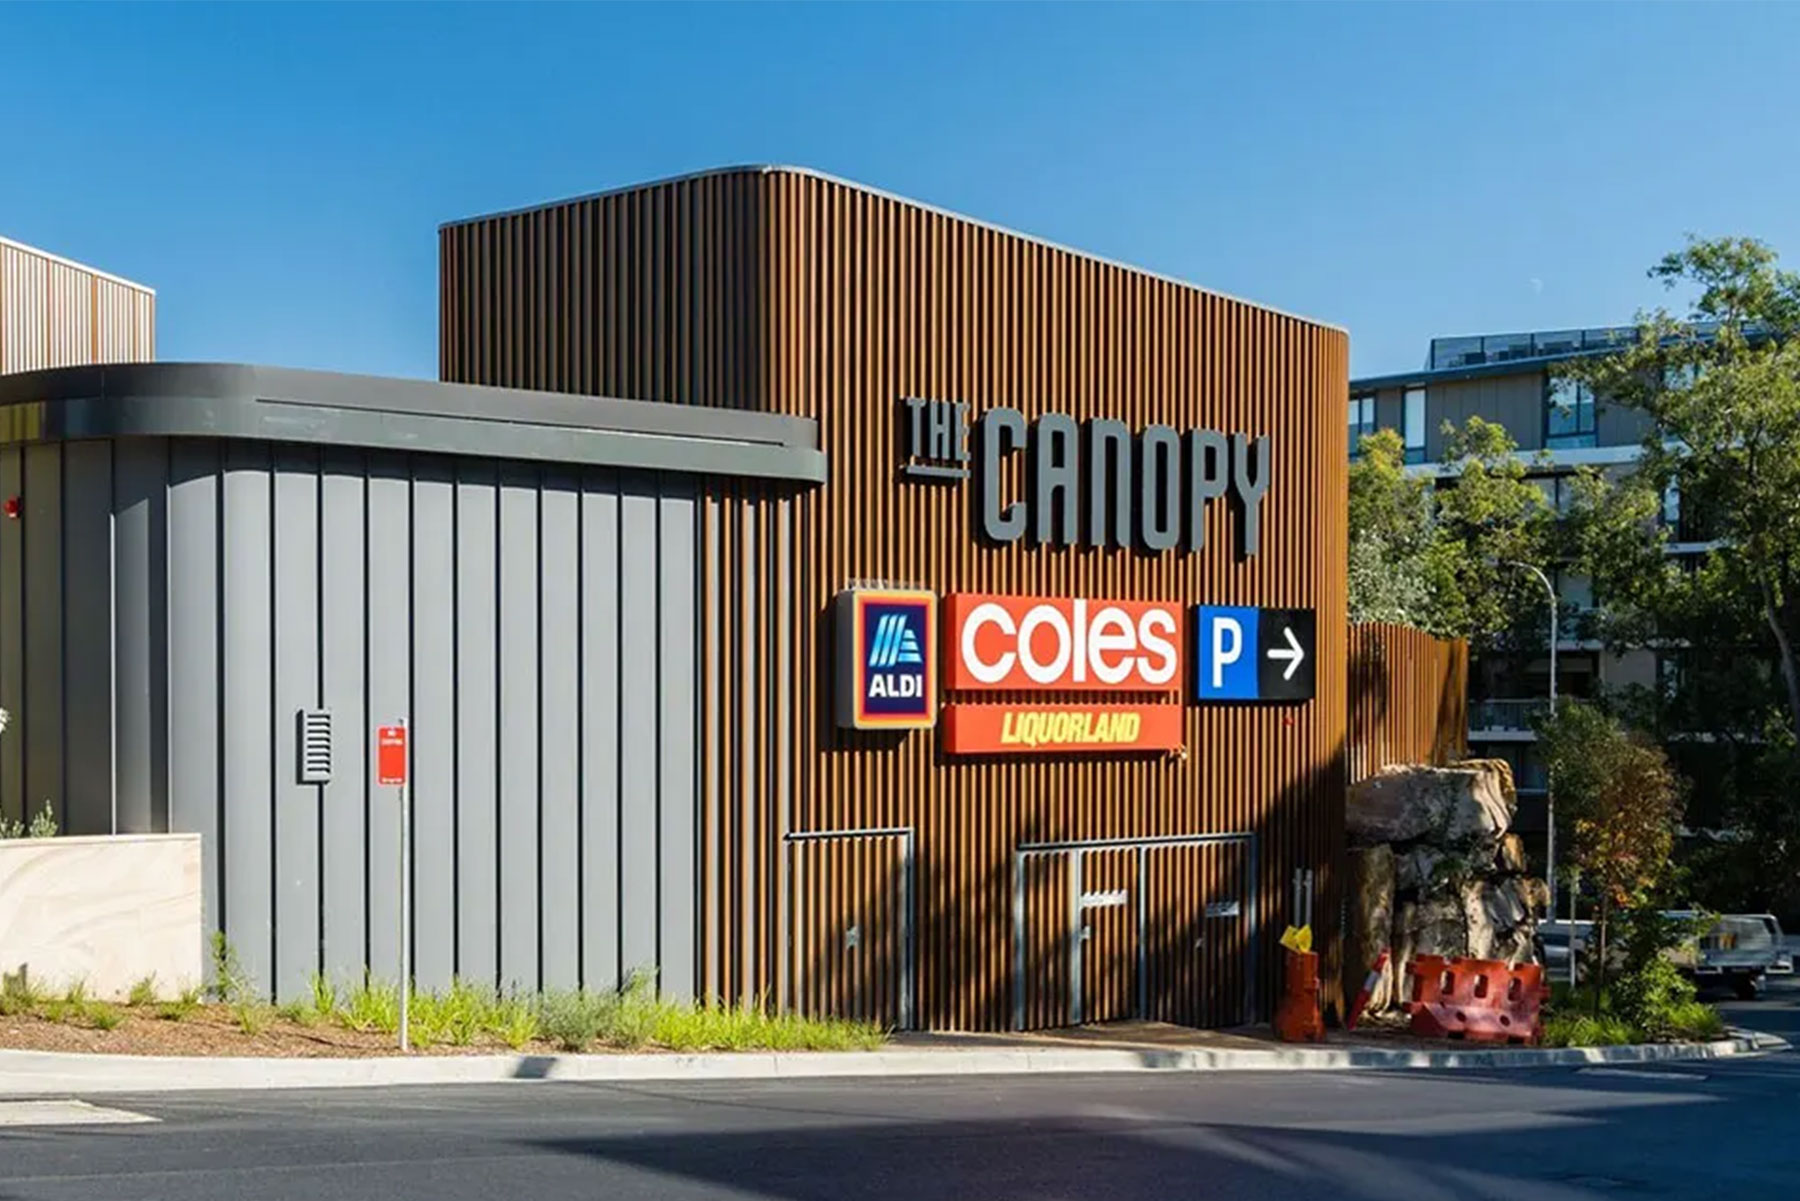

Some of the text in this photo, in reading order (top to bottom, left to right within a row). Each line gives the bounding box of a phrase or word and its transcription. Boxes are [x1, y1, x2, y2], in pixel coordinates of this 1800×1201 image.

[906, 397, 1271, 555] THE CANOPY
[961, 599, 1177, 685] coles
[1212, 616, 1243, 688] P
[868, 675, 923, 698] ALDI
[1000, 712, 1141, 746] LIQUORLAND
